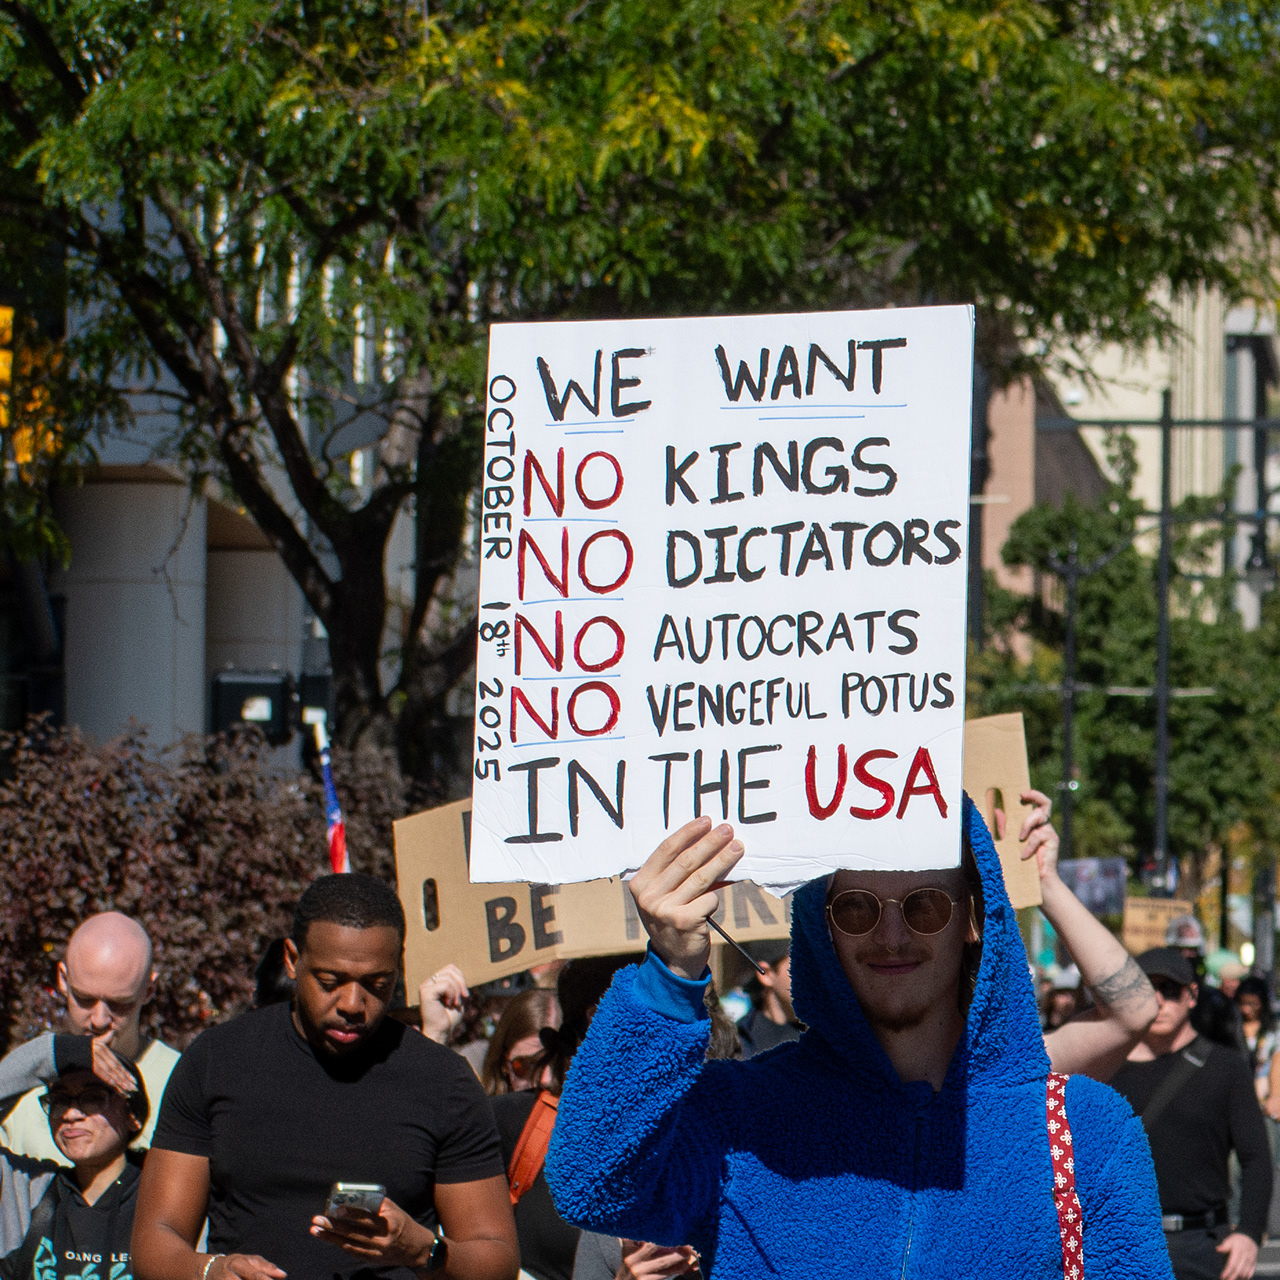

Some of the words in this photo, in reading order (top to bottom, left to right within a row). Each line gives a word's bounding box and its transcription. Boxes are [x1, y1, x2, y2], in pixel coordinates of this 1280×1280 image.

[537, 348, 653, 421] WE
[715, 338, 906, 401] WANT
[484, 375, 517, 560] OCTOBER
[523, 447, 624, 517] NO
[665, 437, 897, 506] KINGS
[518, 526, 633, 600] NO
[667, 519, 961, 588] DICTATORS
[514, 610, 625, 675] NO
[654, 609, 920, 662] AUTOCRATS
[476, 678, 504, 782] 2025
[510, 681, 620, 742] NO
[647, 677, 826, 737] VENGEFUL
[843, 672, 954, 719] POTUS
[505, 757, 625, 843] IN
[648, 744, 782, 829] THE
[805, 743, 948, 820] USA
[485, 882, 564, 963] BE
